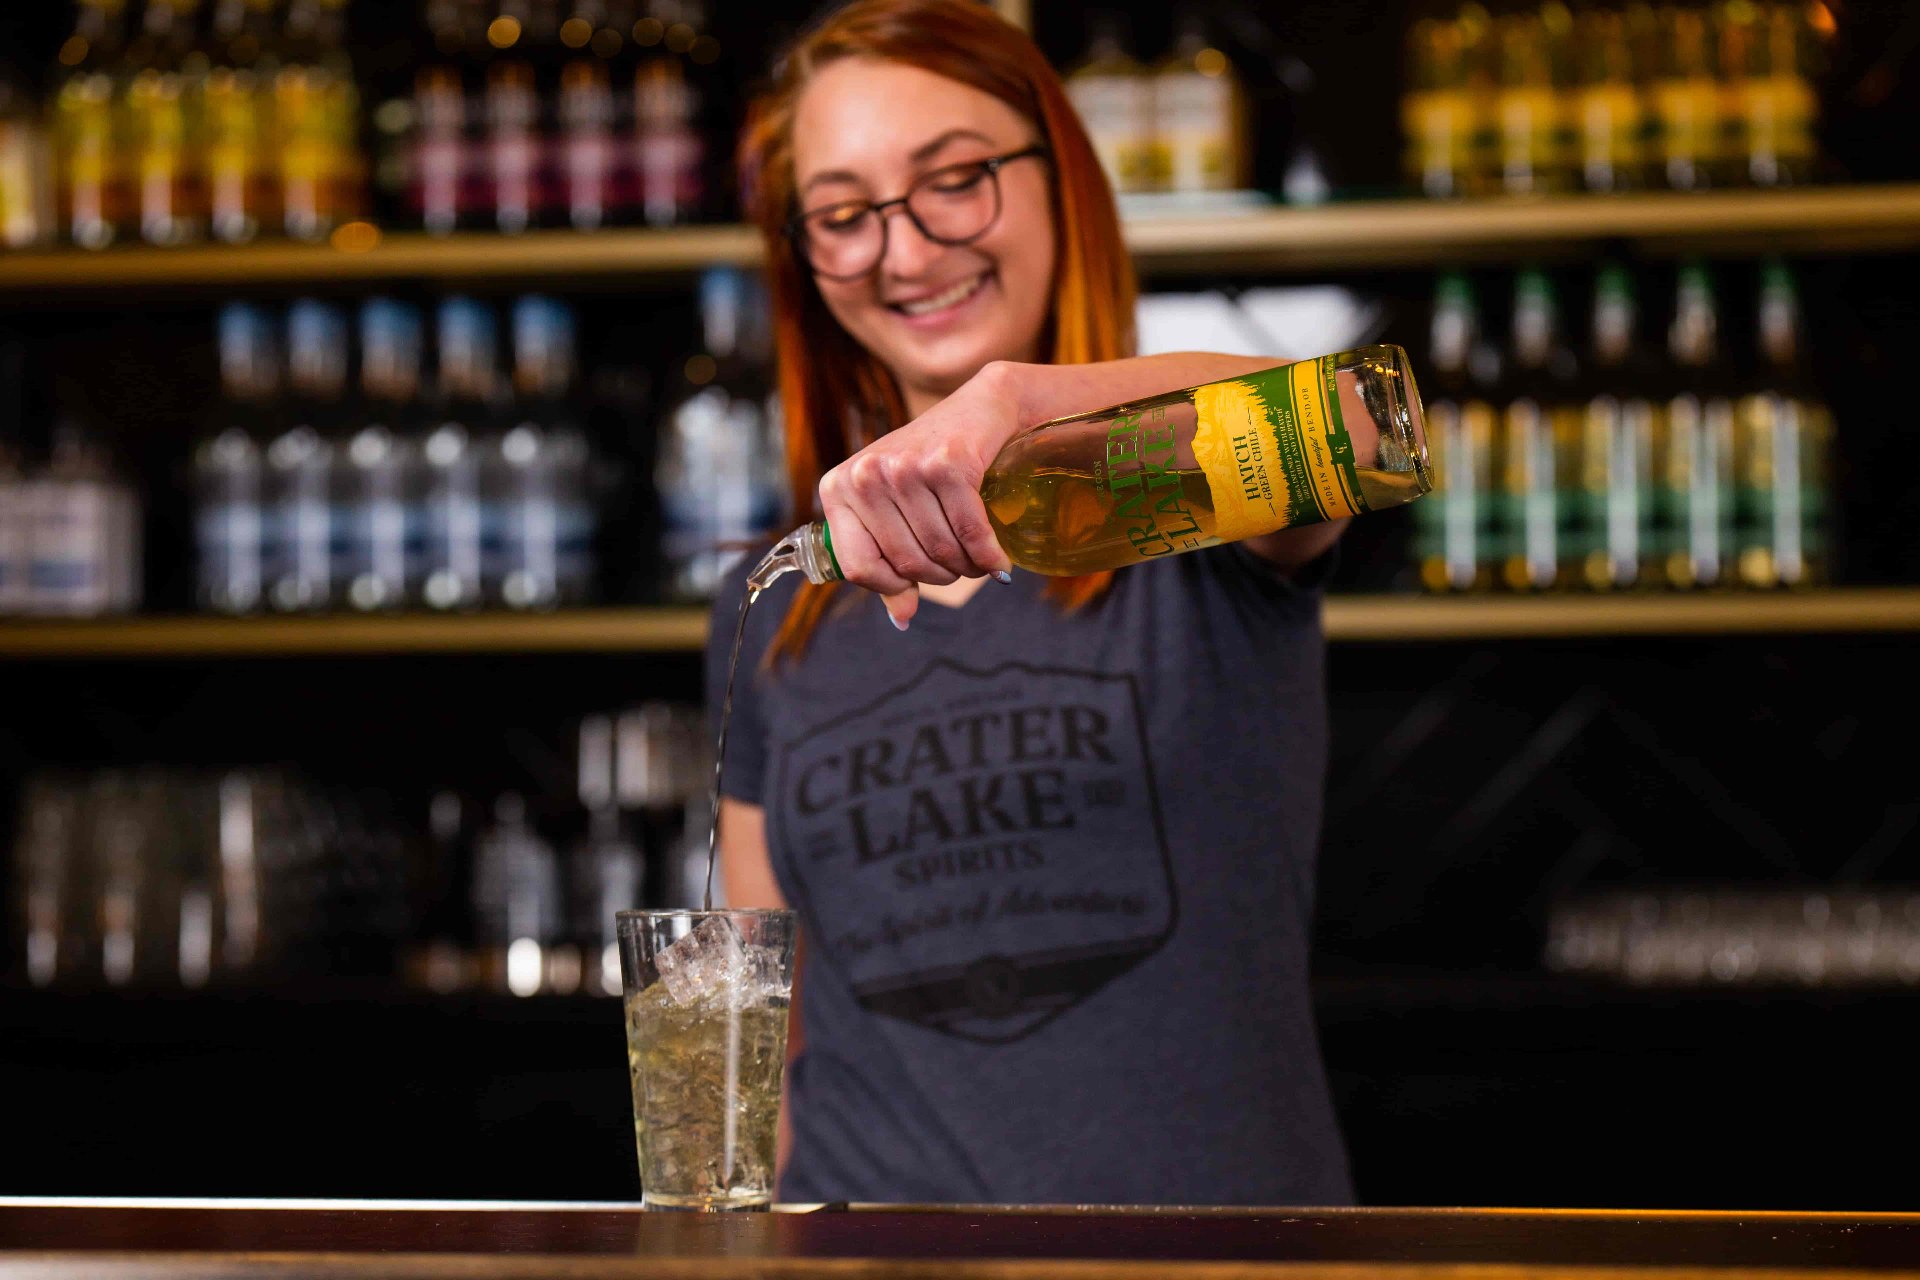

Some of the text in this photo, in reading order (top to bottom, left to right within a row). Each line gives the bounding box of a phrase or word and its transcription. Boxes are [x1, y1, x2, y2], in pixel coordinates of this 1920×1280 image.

[1280, 432, 1290, 454] WITH
[1284, 410, 1295, 440] PEPPERS
[1248, 427, 1273, 500] GREEN CHILE
[1289, 440, 1299, 457] AND
[1308, 436, 1324, 468] beautiful
[1106, 412, 1174, 557] CRATER
[1143, 423, 1203, 539] LAKE
[1233, 435, 1261, 501] HATCH
[1285, 454, 1298, 483] INFUSED
[1319, 472, 1329, 483] IN
[1323, 485, 1336, 507] MADE
[795, 704, 1118, 816] CRATER
[846, 769, 1076, 864] LAKE
[894, 842, 1045, 885] SPIRITS
